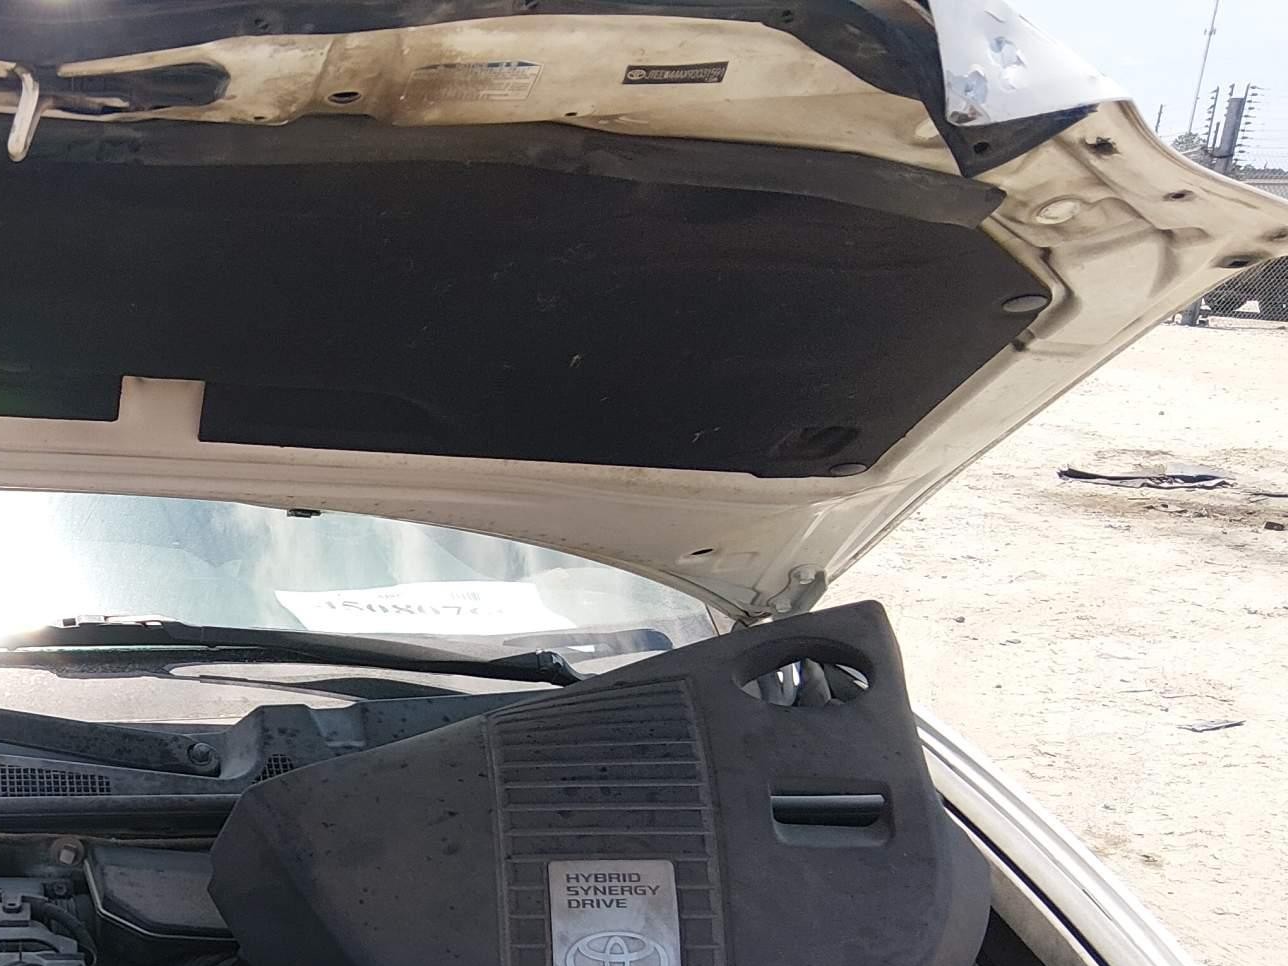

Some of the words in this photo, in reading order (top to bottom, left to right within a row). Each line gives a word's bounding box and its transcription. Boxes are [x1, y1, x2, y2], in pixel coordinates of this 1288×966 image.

[566, 873, 641, 883] HYBRID
[567, 885, 660, 896] SYNERGY
[567, 898, 628, 909] DRIVE
